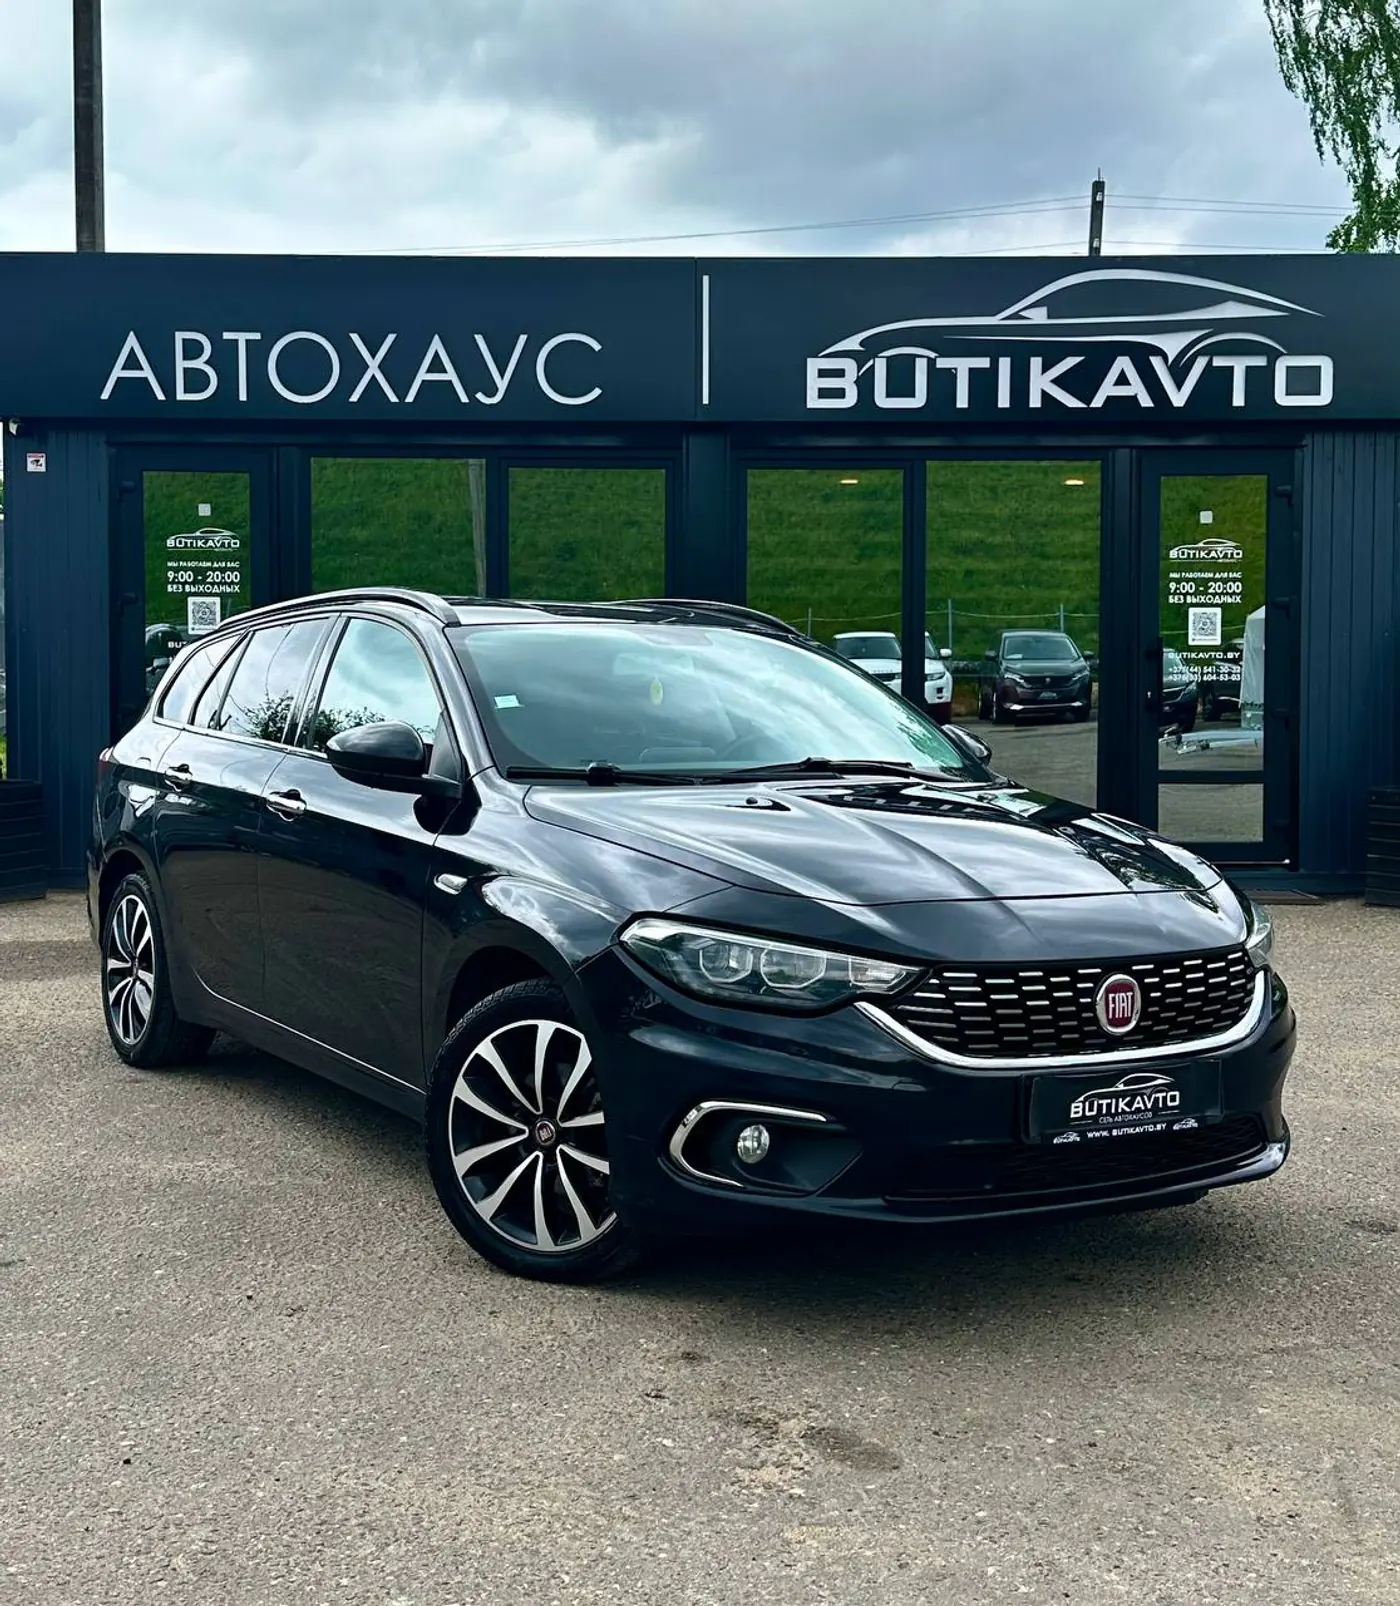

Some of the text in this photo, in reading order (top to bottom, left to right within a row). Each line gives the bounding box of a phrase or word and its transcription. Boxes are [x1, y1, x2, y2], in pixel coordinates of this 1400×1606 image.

[101, 330, 603, 406] АВТОХАУС
[806, 354, 1334, 409] BUTIKAVTO
[166, 539, 240, 547] BUTIKAVTO
[1169, 550, 1243, 558] BUTIKAVTO
[167, 571, 194, 582] 9:00
[206, 571, 240, 582] 20:00
[167, 584, 240, 593] БЕЗ ВЫХОДНЫХ
[1169, 582, 1196, 593] 9:00
[1207, 582, 1242, 593] 20:00
[1168, 595, 1242, 604] БЕЗ ВЫХОДНЫХ
[1108, 992, 1133, 1019] FIAT
[1070, 1091, 1180, 1118] BUTIKAVTO
